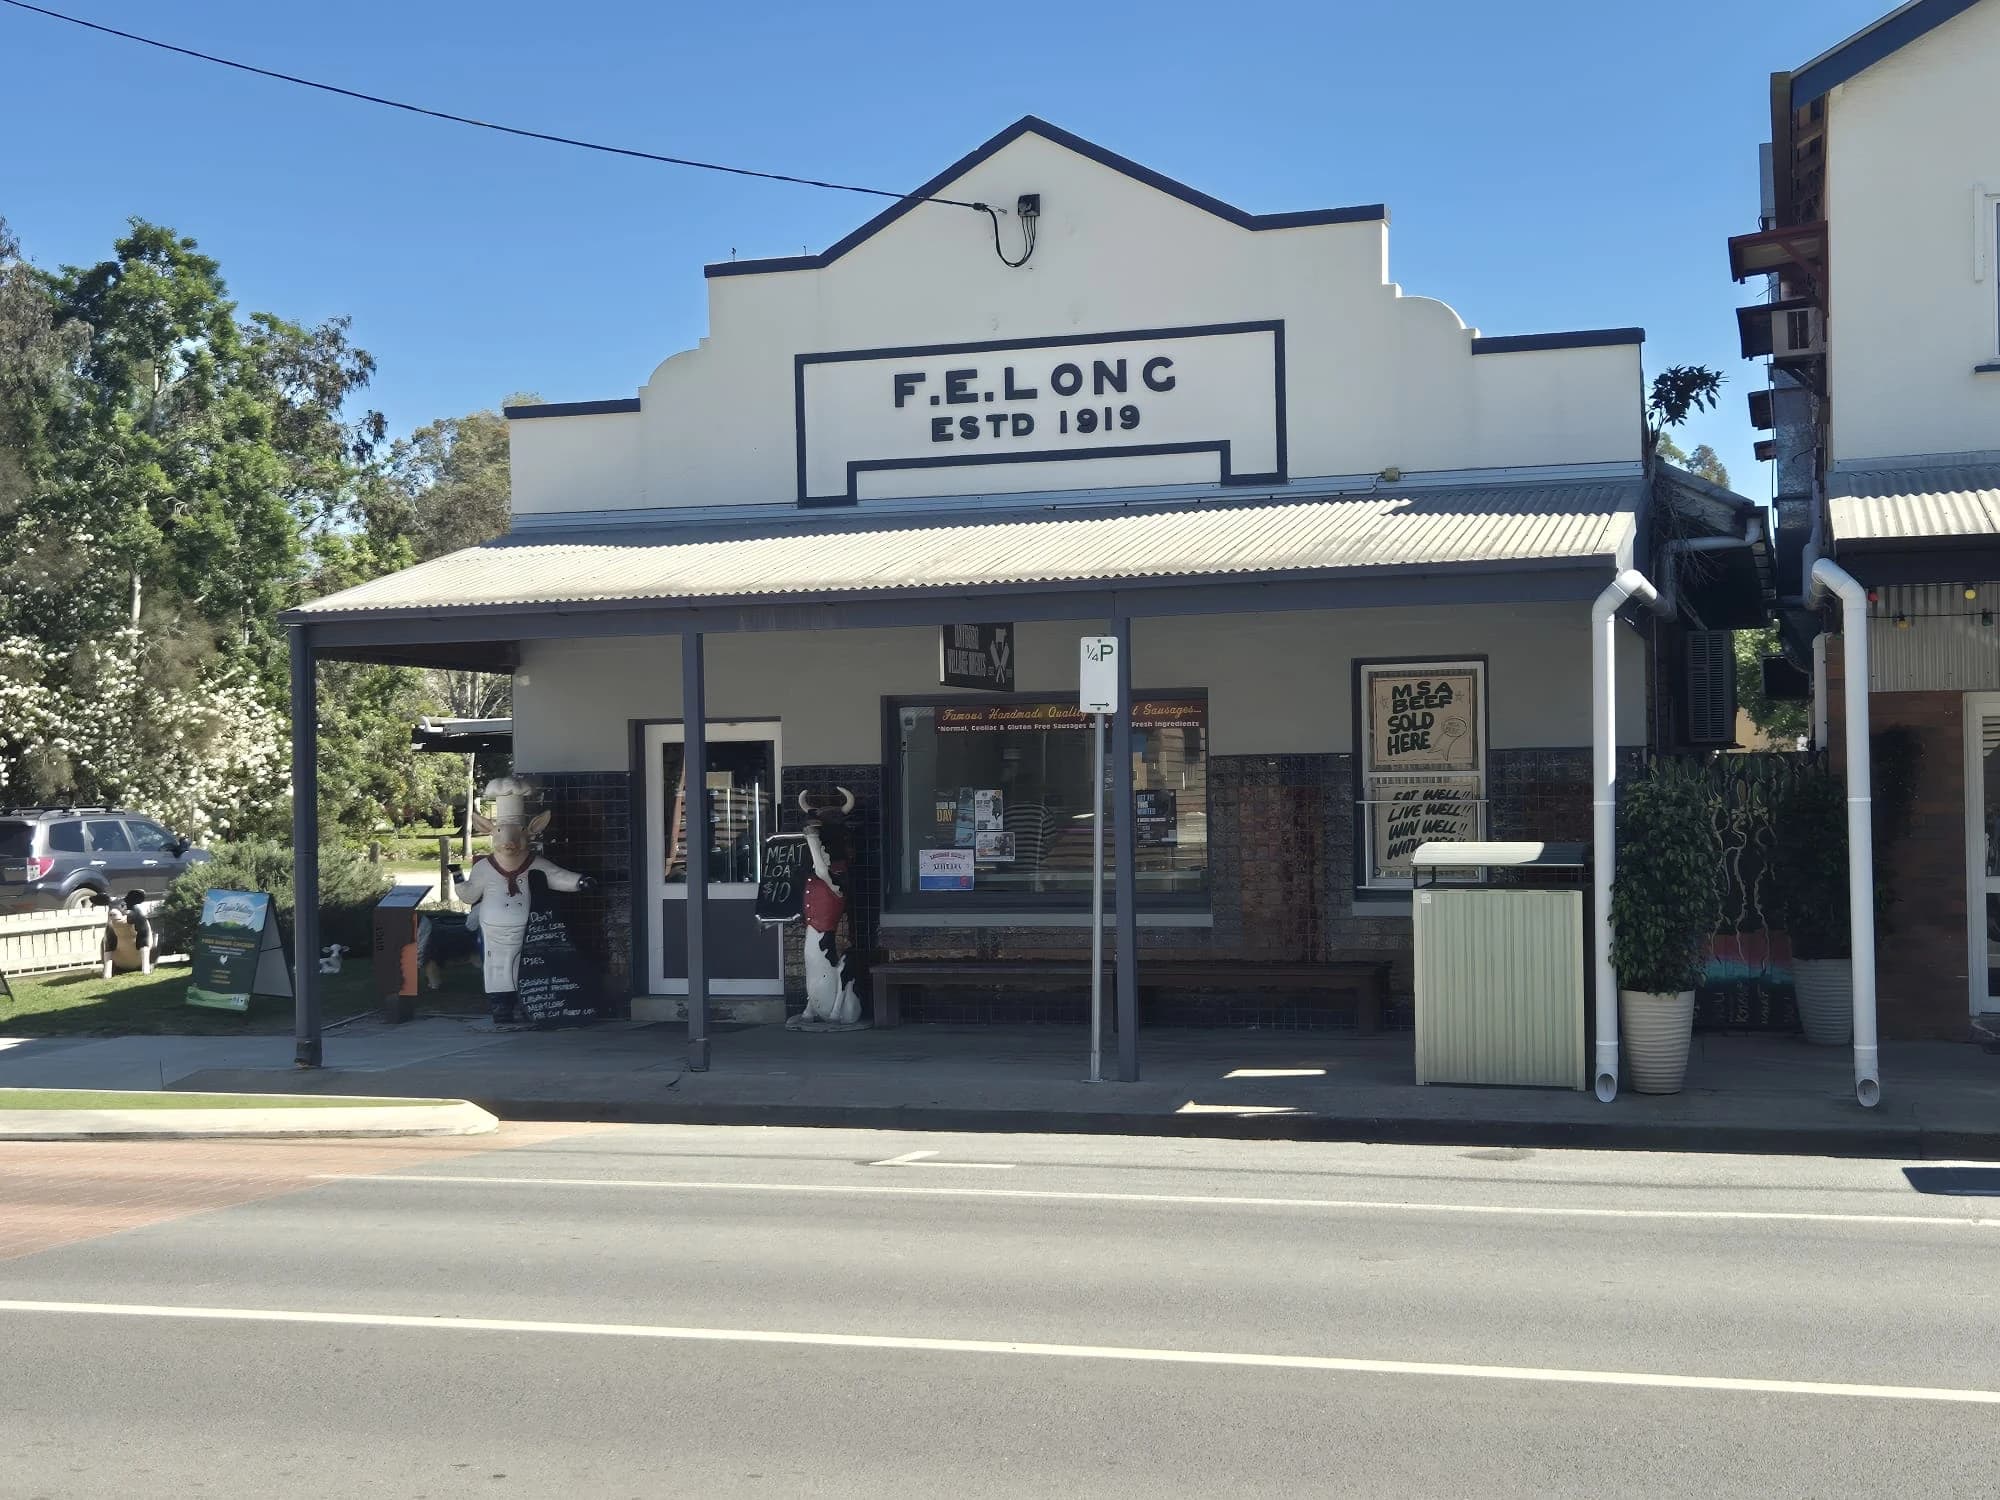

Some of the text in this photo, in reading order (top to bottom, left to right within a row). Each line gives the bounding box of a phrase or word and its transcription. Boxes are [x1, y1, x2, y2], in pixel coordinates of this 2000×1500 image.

[931, 404, 1141, 442] ESTD 1919
[1391, 680, 1453, 700] MSA
[942, 708, 983, 720] Famous
[988, 707, 1042, 720] Handmade
[1048, 706, 1087, 721] Quality
[1392, 694, 1453, 715] BEEF
[1007, 723, 1032, 731] Gluten
[1053, 722, 1087, 730] Sausages
[1387, 711, 1435, 735] SOLD
[1387, 731, 1432, 756] HERE
[1392, 789, 1419, 805] EAT
[936, 809, 953, 822] DAY
[1388, 804, 1423, 822] LIVE
[1388, 819, 1420, 840] WIN
[766, 843, 807, 864] MEAT
[763, 881, 791, 903] $10
